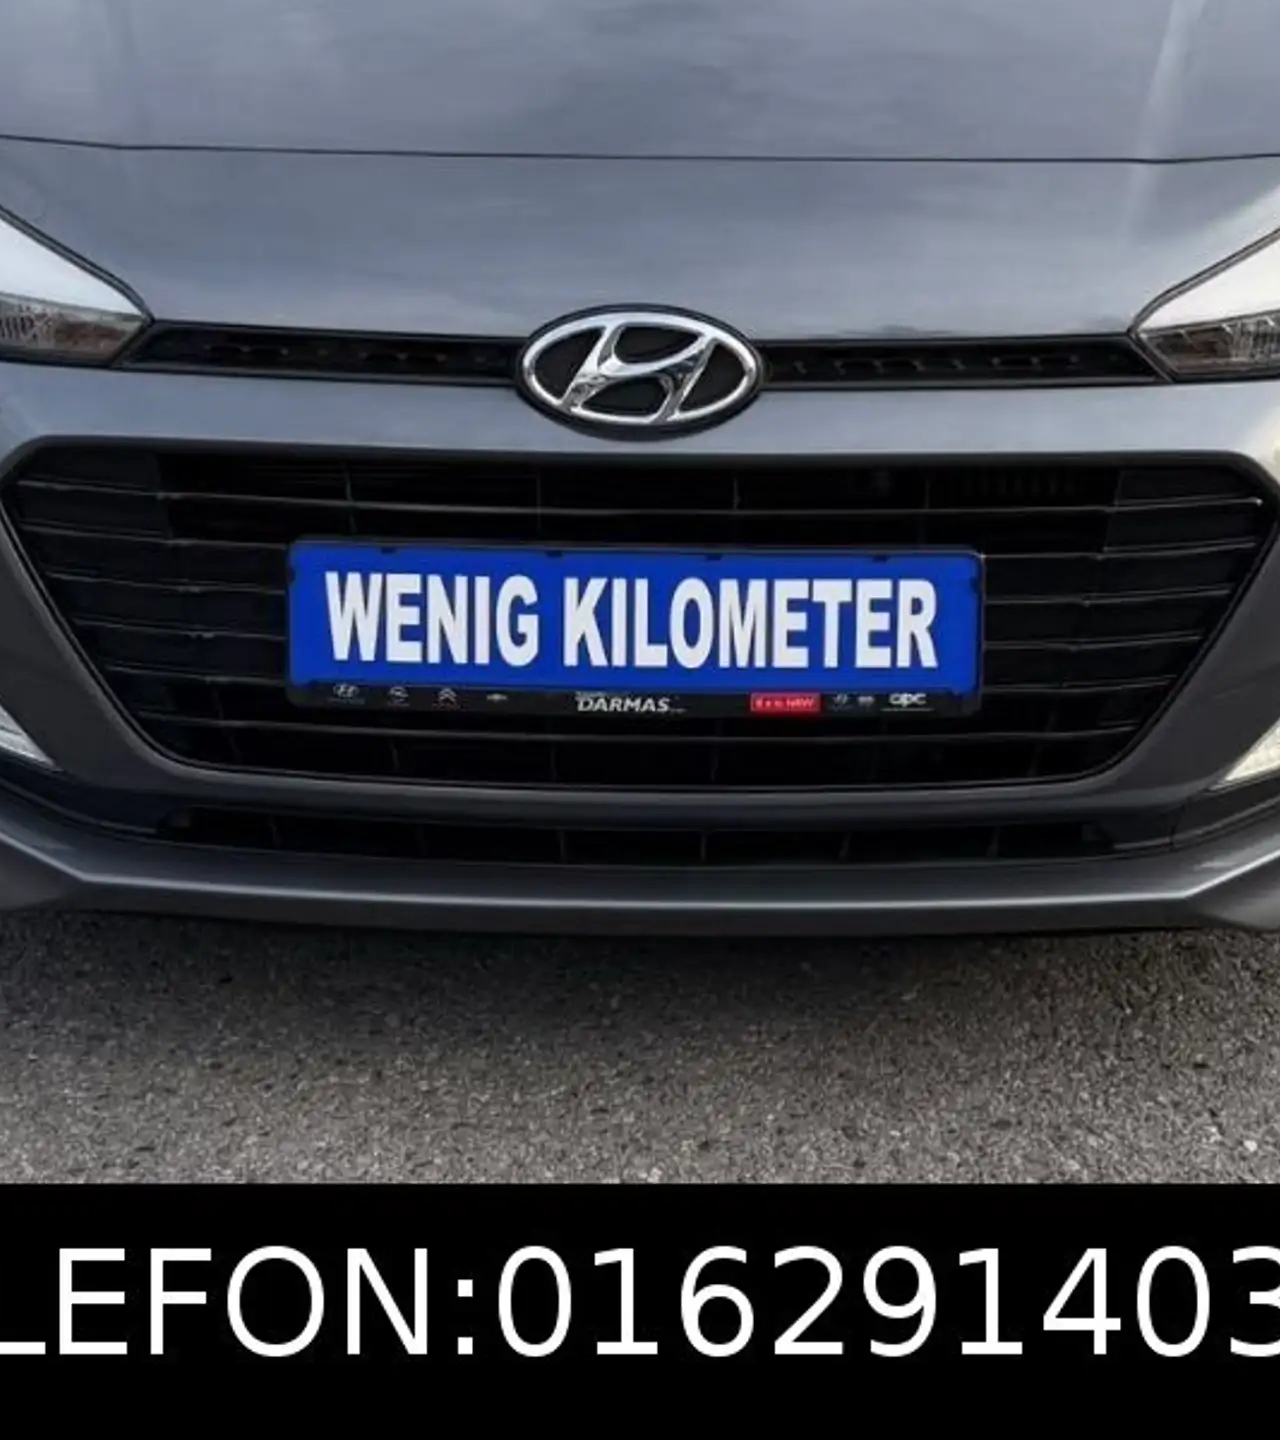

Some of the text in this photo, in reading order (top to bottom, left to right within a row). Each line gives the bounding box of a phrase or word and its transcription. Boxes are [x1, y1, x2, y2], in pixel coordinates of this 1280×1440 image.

[324, 571, 938, 670] WENIG KILOMETER
[576, 697, 671, 713] DARMAS
